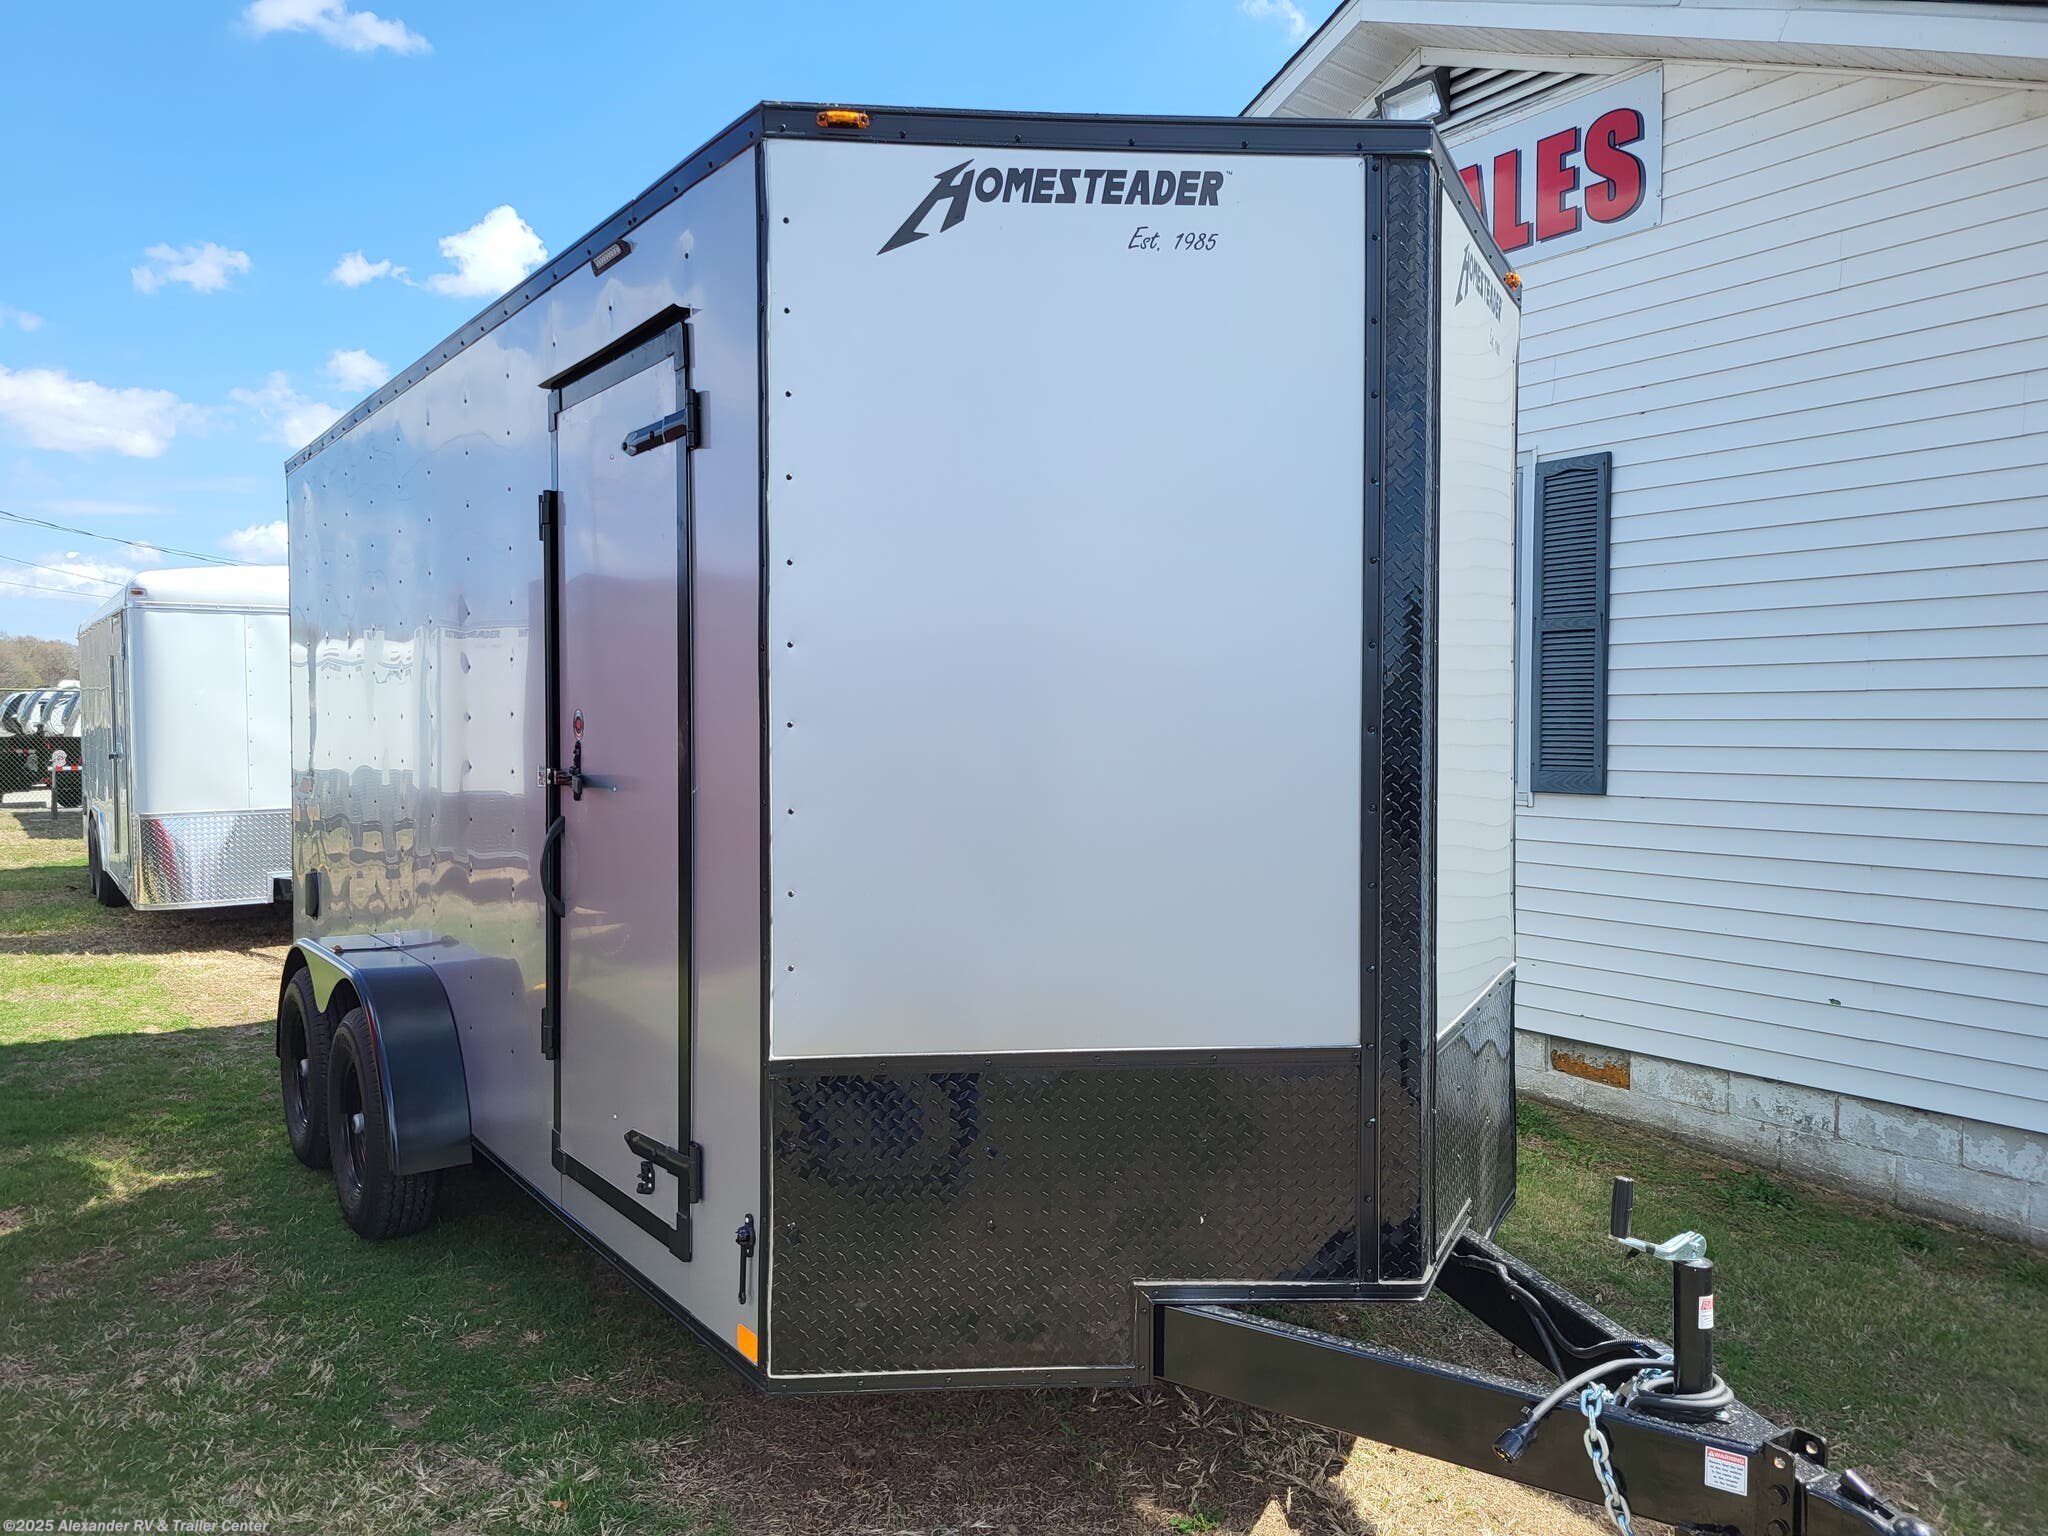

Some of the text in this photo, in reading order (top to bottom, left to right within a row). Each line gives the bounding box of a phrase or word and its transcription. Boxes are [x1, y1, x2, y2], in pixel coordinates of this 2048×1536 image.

[877, 158, 1224, 256] HOMESTEADER
[1128, 226, 1219, 251] Est. 1985
[1714, 1451, 1745, 1465] WARNING
